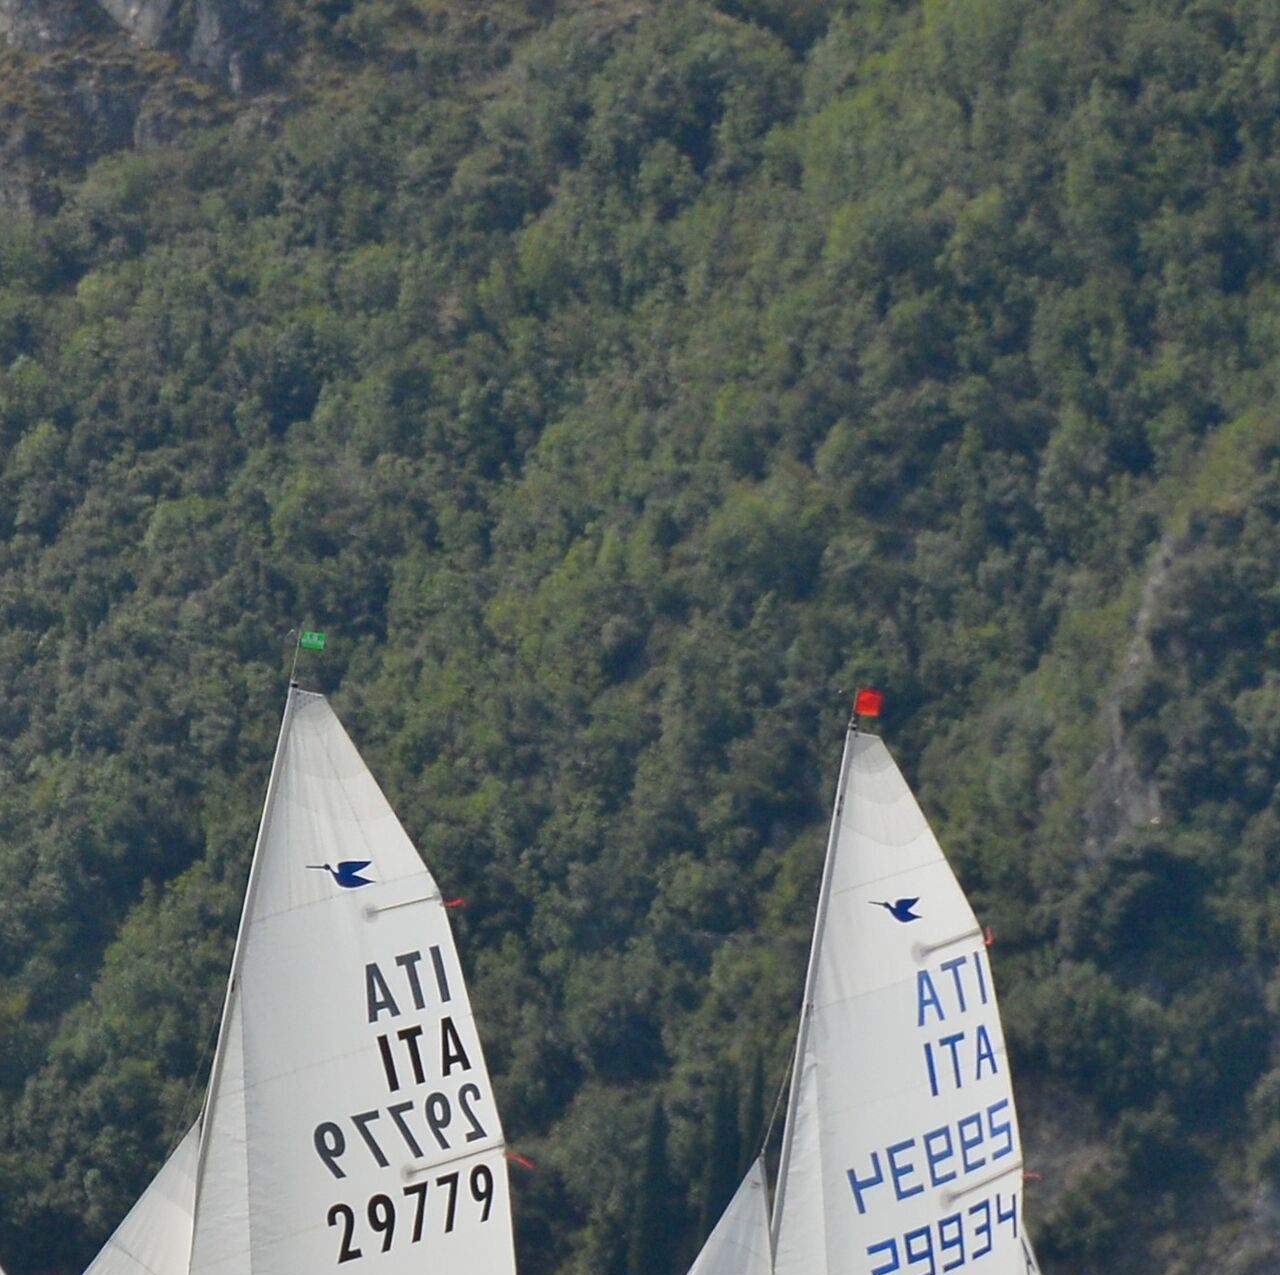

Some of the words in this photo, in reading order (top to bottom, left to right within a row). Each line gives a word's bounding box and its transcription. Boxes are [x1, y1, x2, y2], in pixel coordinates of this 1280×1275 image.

[377, 1016, 471, 1092] ITA
[924, 1024, 998, 1097] ITA
[327, 1164, 494, 1264] 29779
